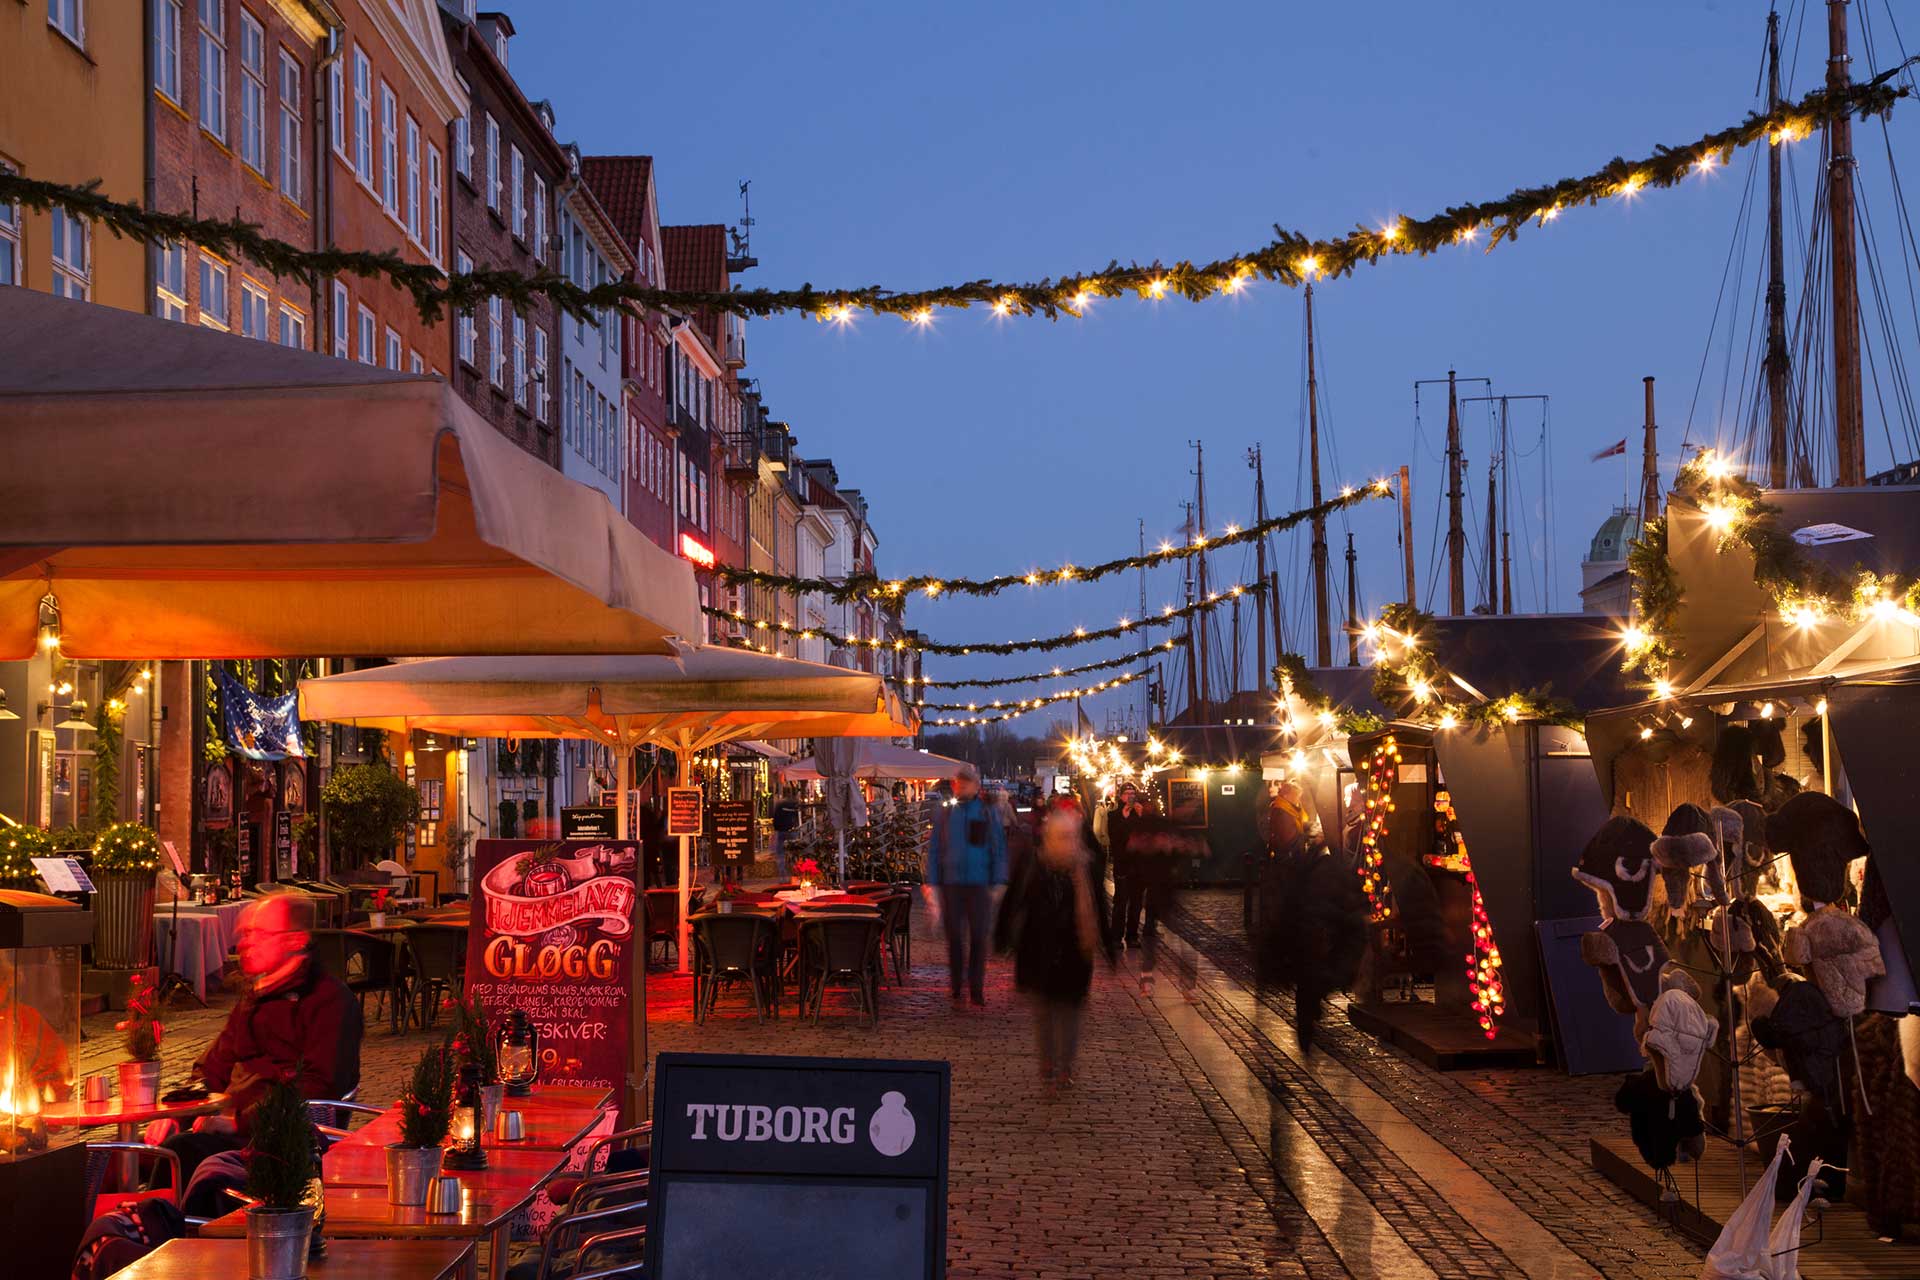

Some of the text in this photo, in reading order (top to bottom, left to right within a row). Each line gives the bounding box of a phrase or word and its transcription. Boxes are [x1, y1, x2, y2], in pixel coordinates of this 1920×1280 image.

[484, 935, 614, 980] GLØGG
[471, 983, 493, 995] MED
[686, 1103, 855, 1144] TUBORG
